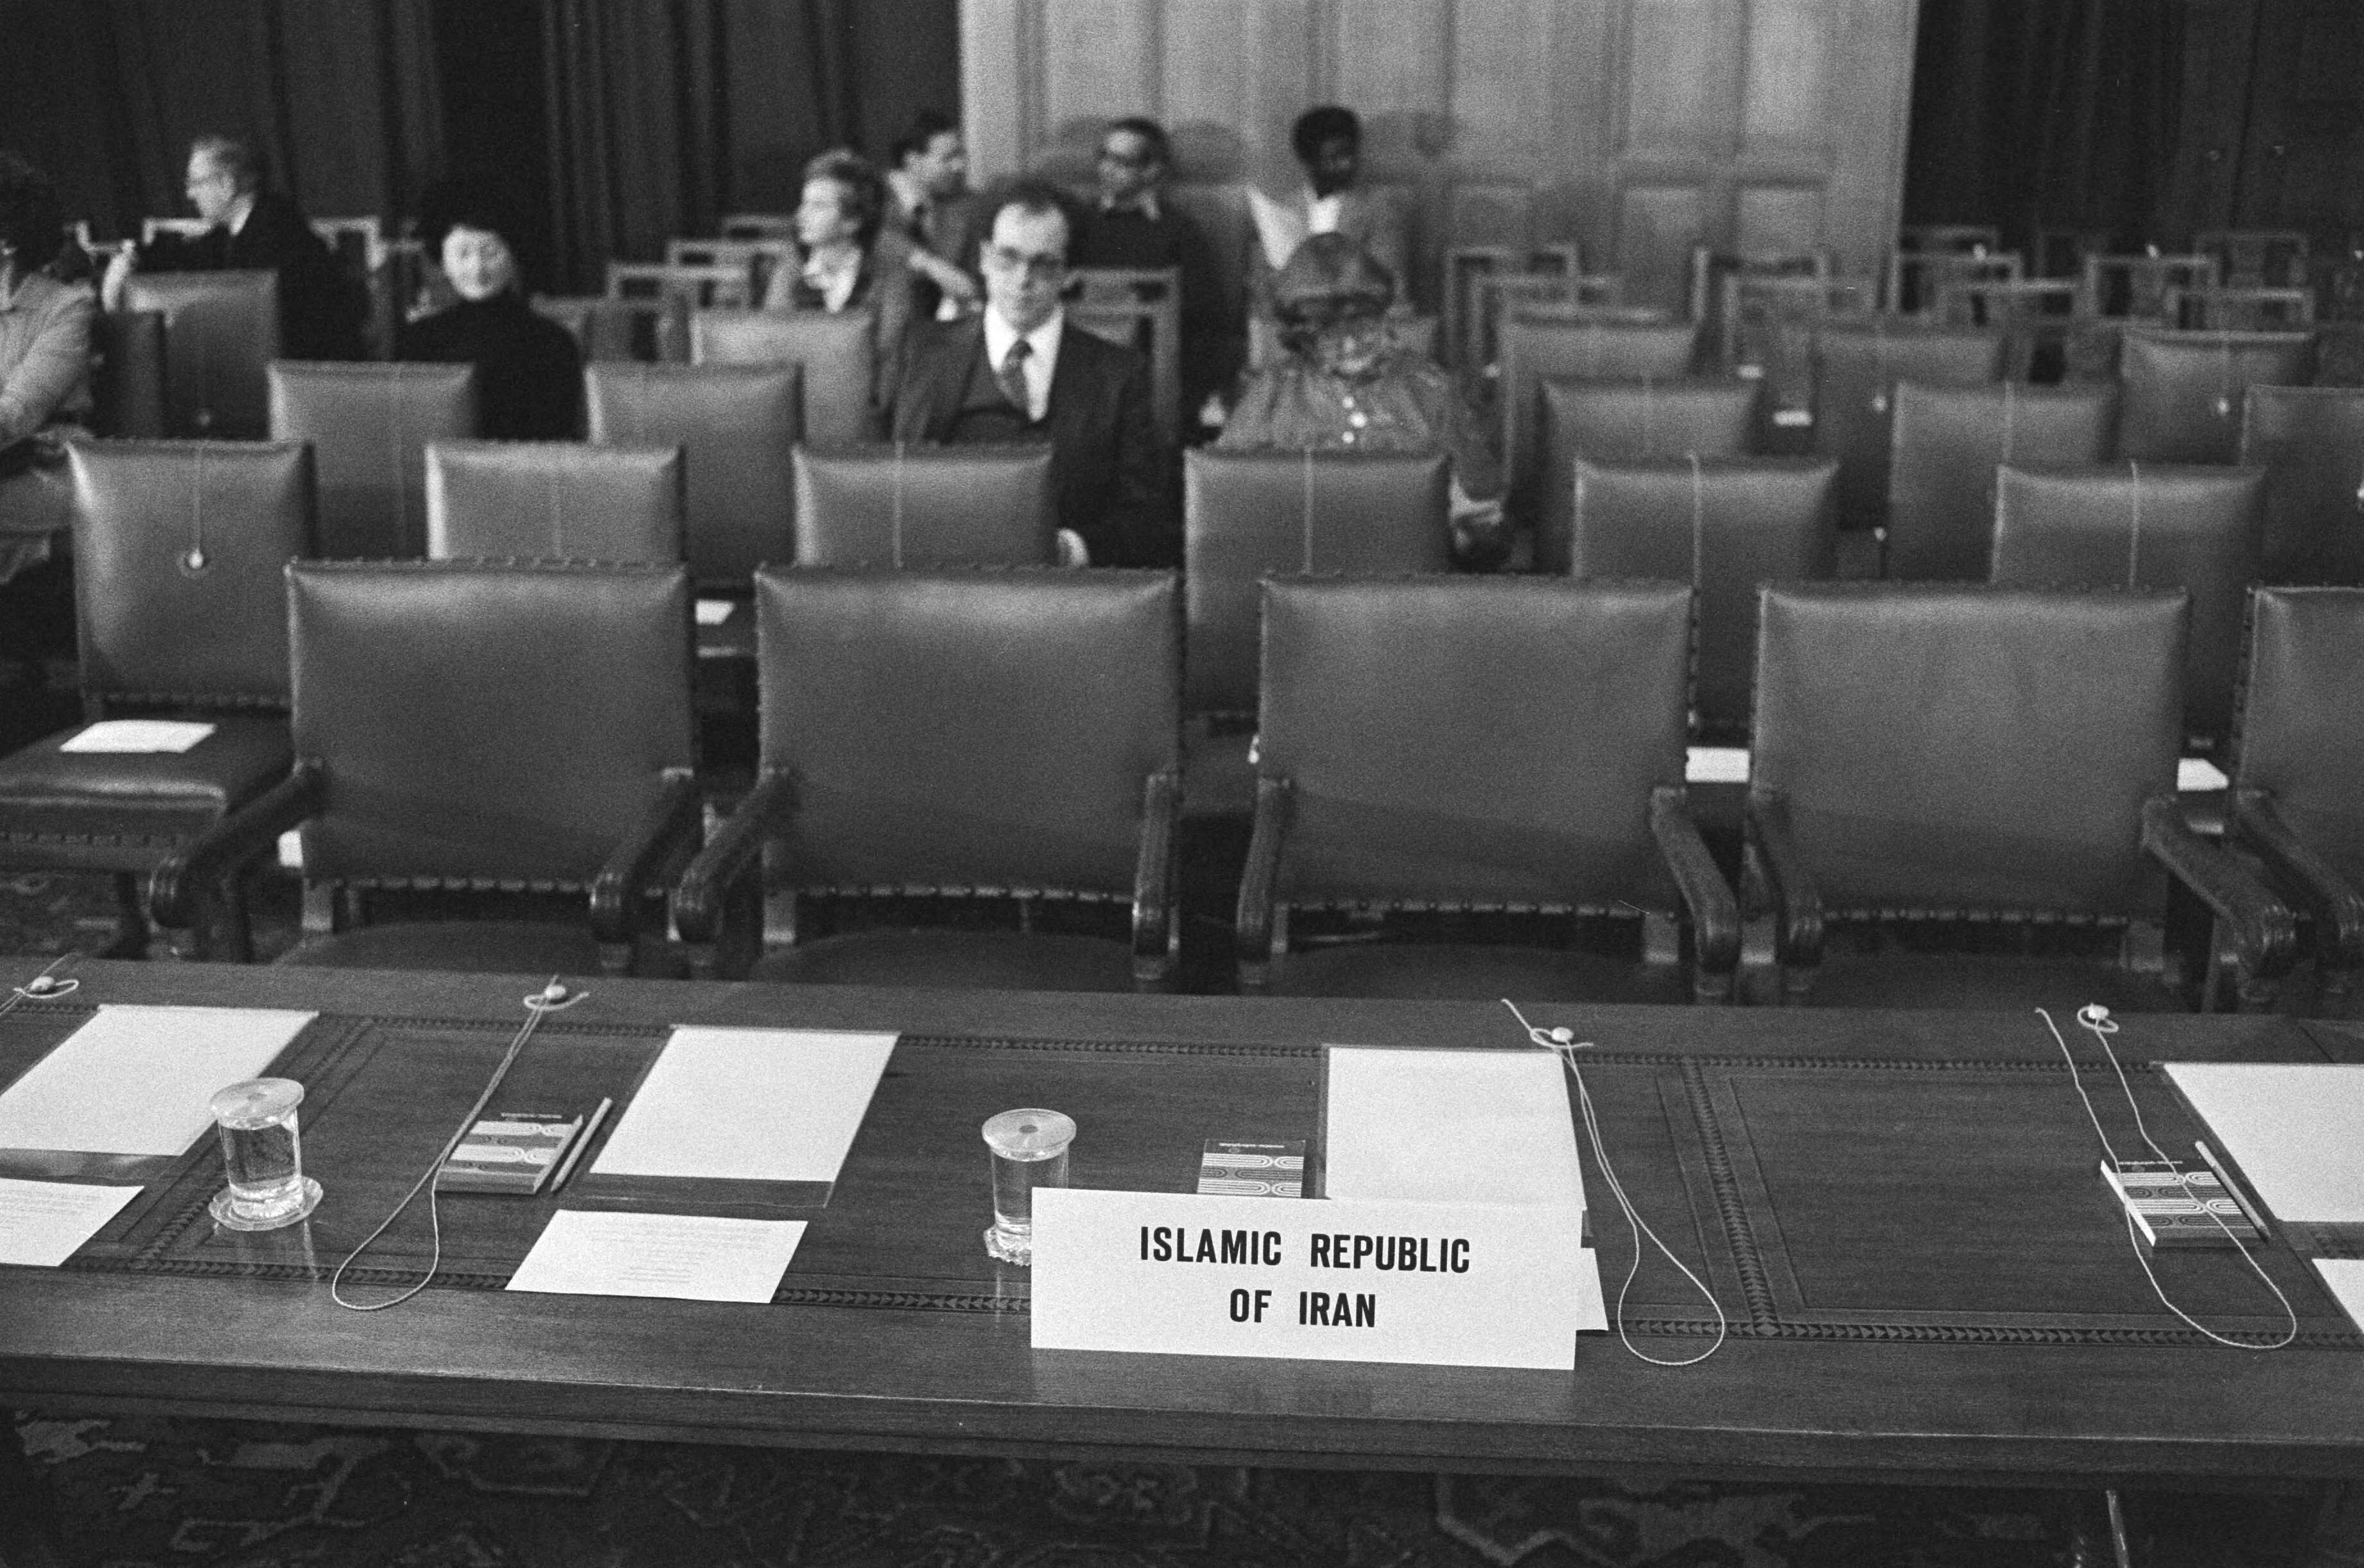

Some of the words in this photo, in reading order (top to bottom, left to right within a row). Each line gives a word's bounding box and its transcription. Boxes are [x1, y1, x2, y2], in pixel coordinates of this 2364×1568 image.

[1141, 1226, 1282, 1266] ISLAMIC
[1310, 1233, 1470, 1273] REPUBLIC
[1230, 1288, 1272, 1323] OF
[1299, 1291, 1375, 1328] IRAN
